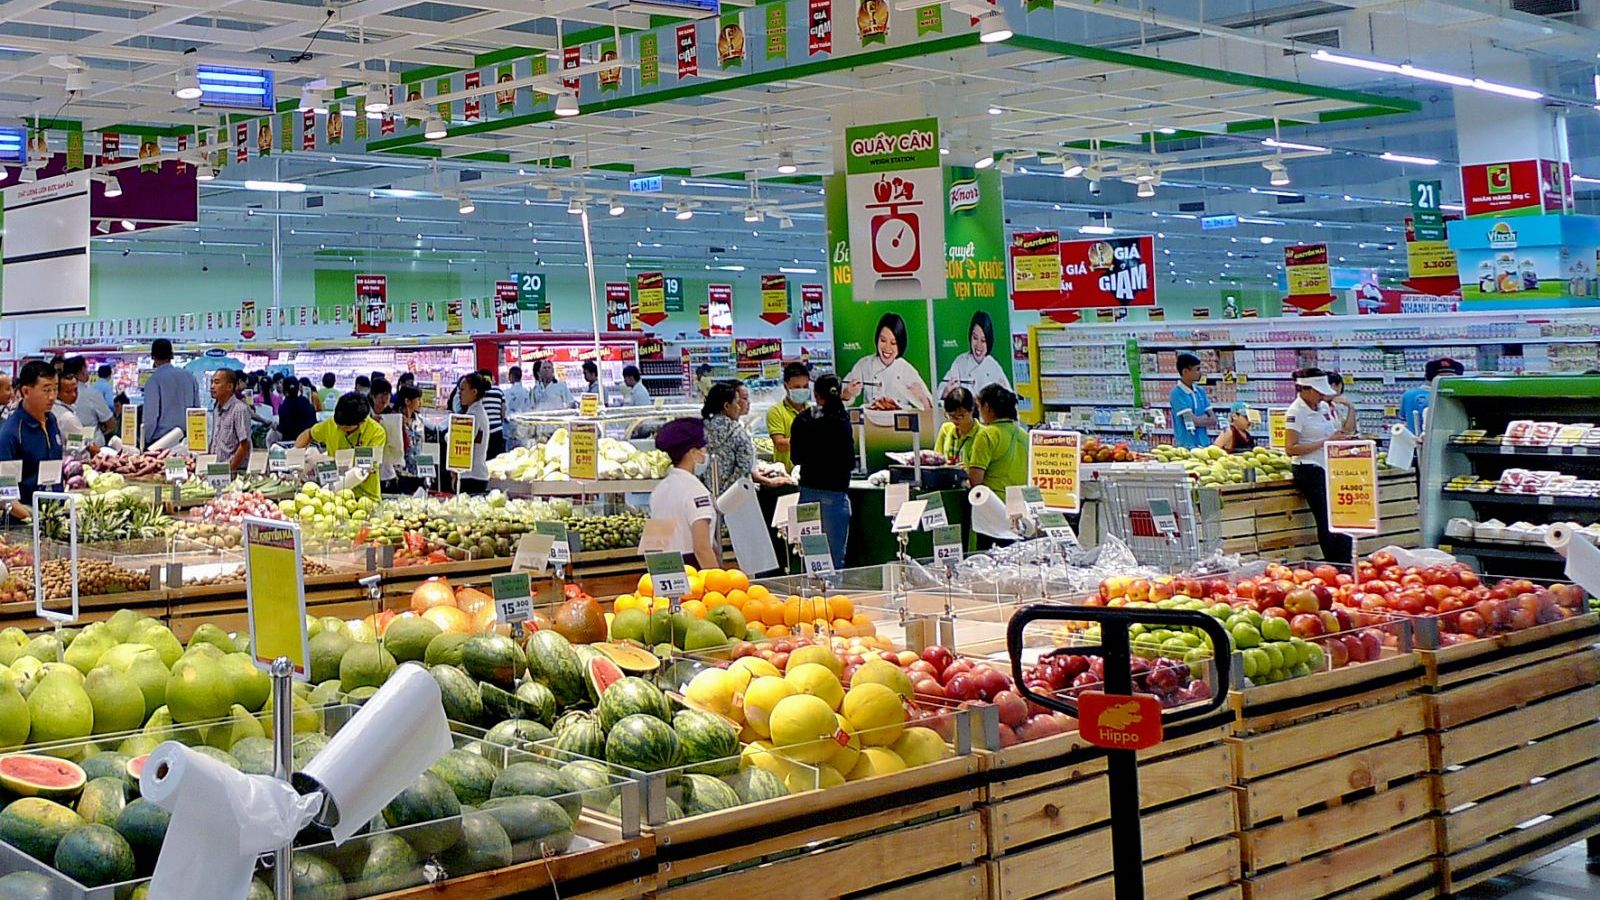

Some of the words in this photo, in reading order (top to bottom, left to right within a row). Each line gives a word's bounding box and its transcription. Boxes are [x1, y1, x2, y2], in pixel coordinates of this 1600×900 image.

[899, 131, 932, 151] CÂN
[951, 187, 980, 205] Knorr
[1418, 184, 1434, 208] 21
[1114, 243, 1140, 260] GIÁ
[1066, 260, 1088, 276] GIÁ
[522, 275, 541, 291] 20
[666, 279, 678, 294] 19
[1098, 264, 1148, 300] GIẢM
[1098, 728, 1140, 744] Hippo
